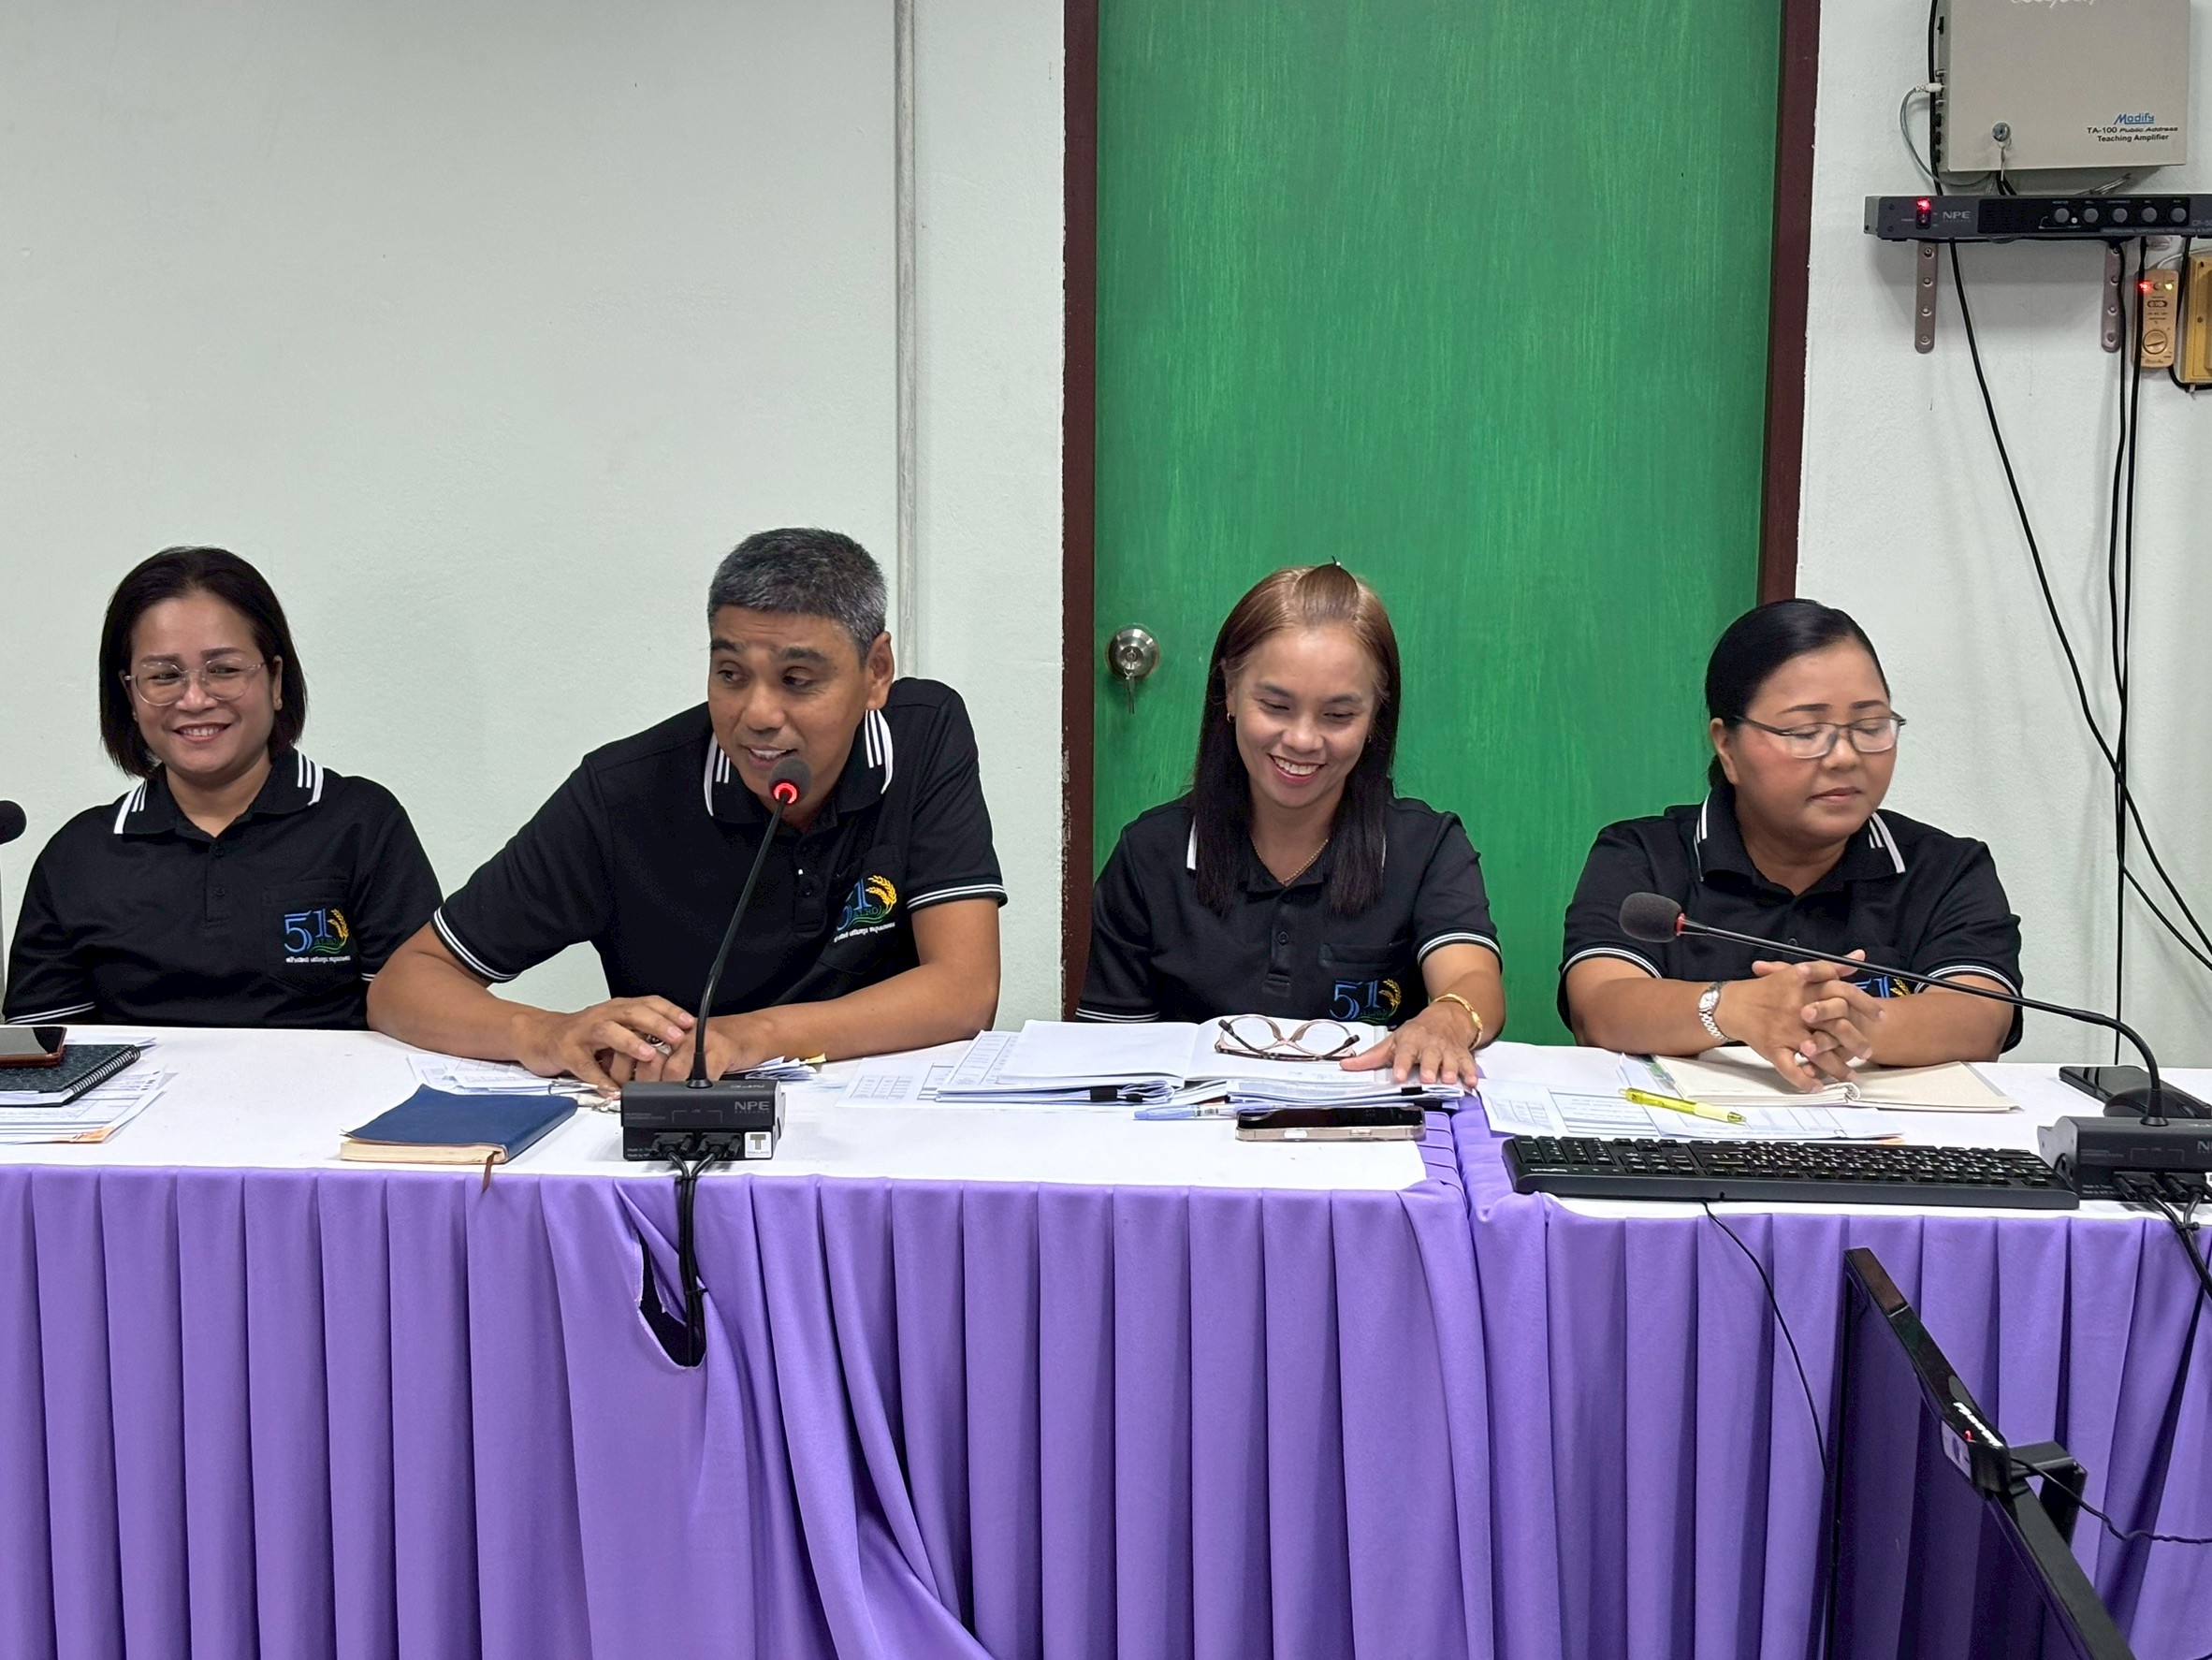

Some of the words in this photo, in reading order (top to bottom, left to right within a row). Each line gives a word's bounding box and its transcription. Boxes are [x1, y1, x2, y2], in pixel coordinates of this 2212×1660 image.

[2113, 112, 2154, 124] Modify
[1943, 211, 1972, 219] NPE
[284, 908, 332, 954] 51
[1329, 979, 1381, 1020] 51
[735, 1100, 770, 1111] NPE
